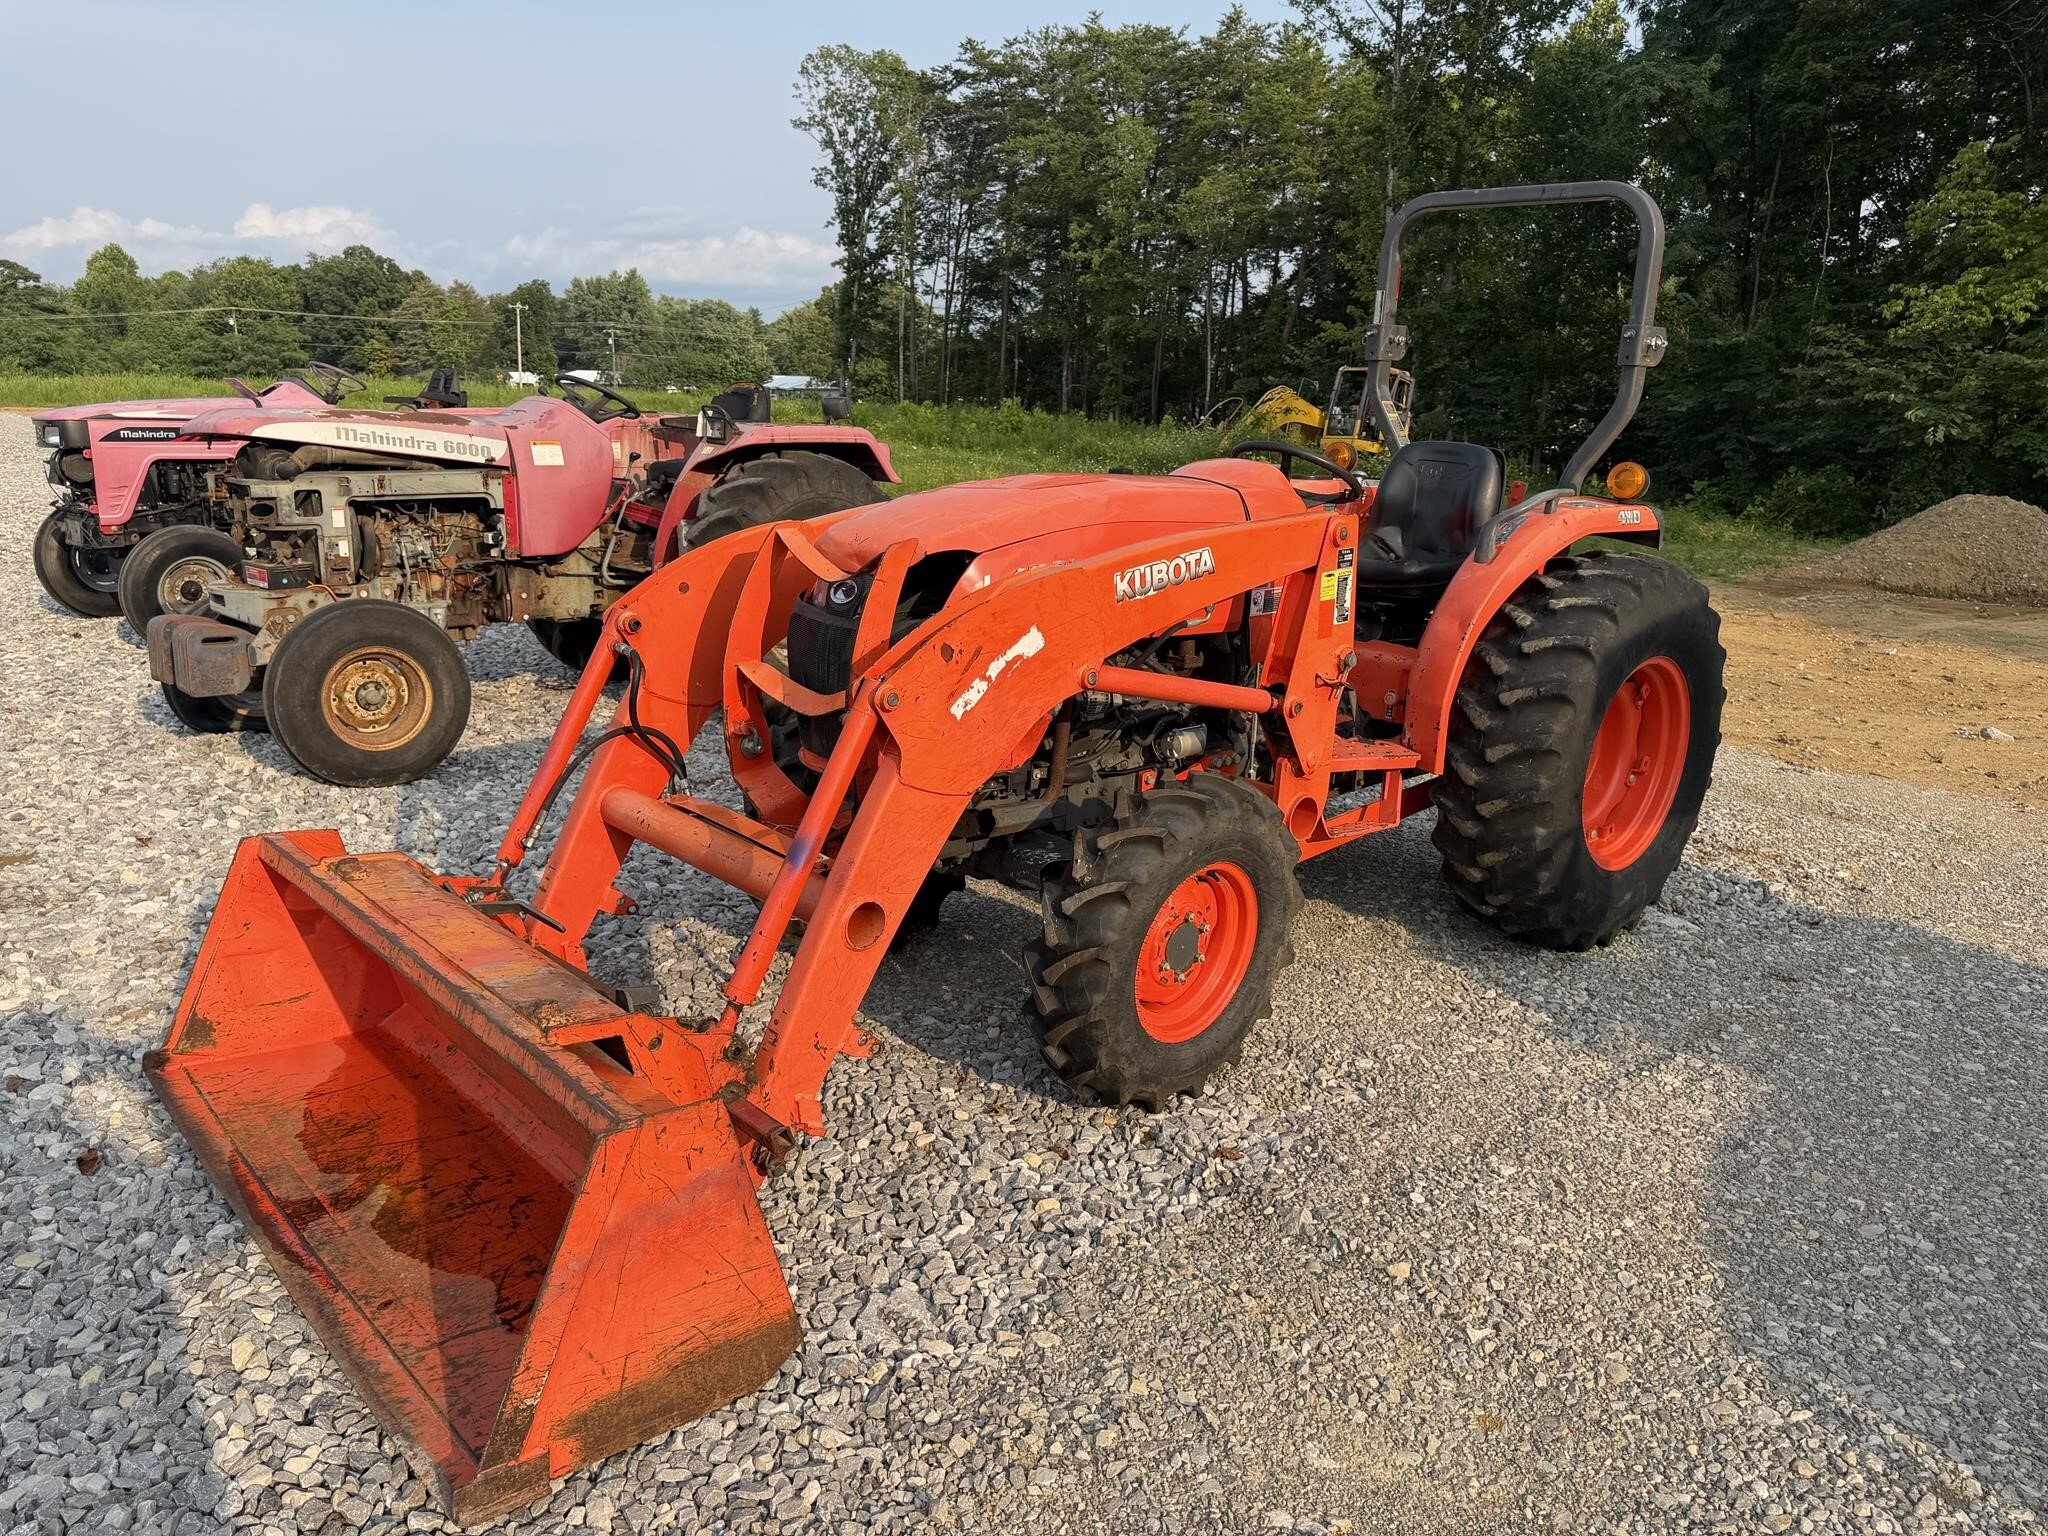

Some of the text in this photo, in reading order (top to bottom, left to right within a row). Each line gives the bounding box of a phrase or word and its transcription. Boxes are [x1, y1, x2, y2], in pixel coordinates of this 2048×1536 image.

[120, 430, 177, 439] Mahindra
[335, 426, 492, 458] Mahindra 6000
[1617, 510, 1641, 525] 4WD
[1115, 548, 1215, 603] KUBOTA
